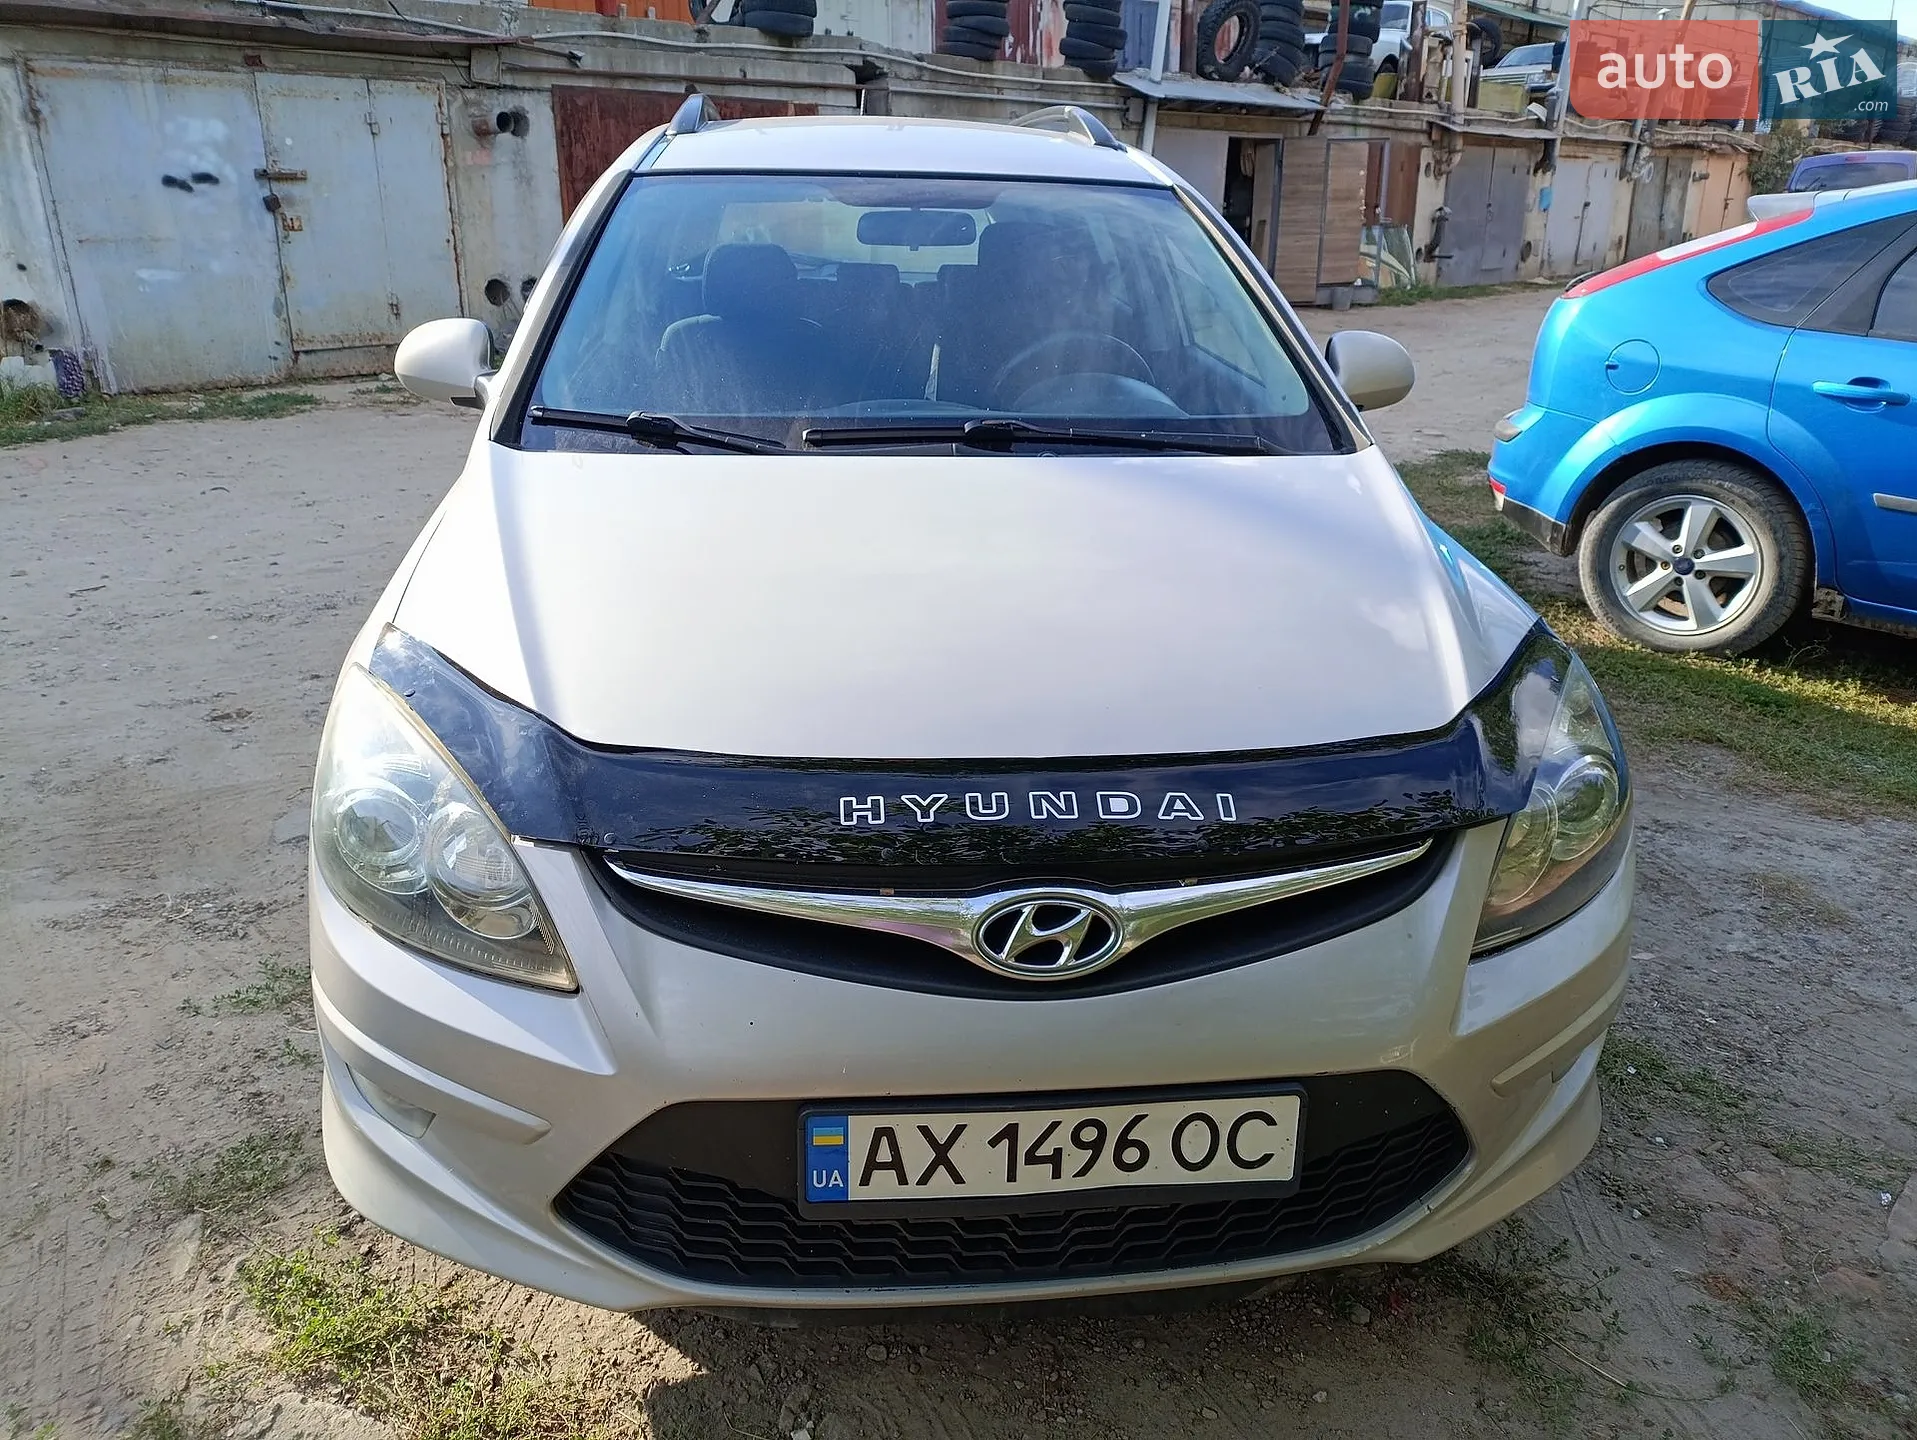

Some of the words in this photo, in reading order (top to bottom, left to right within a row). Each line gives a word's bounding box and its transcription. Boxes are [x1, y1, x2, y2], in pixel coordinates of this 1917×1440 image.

[840, 791, 1236, 825] HYUNDAI
[858, 1123, 967, 1187] AX
[987, 1114, 1150, 1183] 1496
[1171, 1110, 1278, 1172] OC
[812, 1170, 844, 1188] UA
